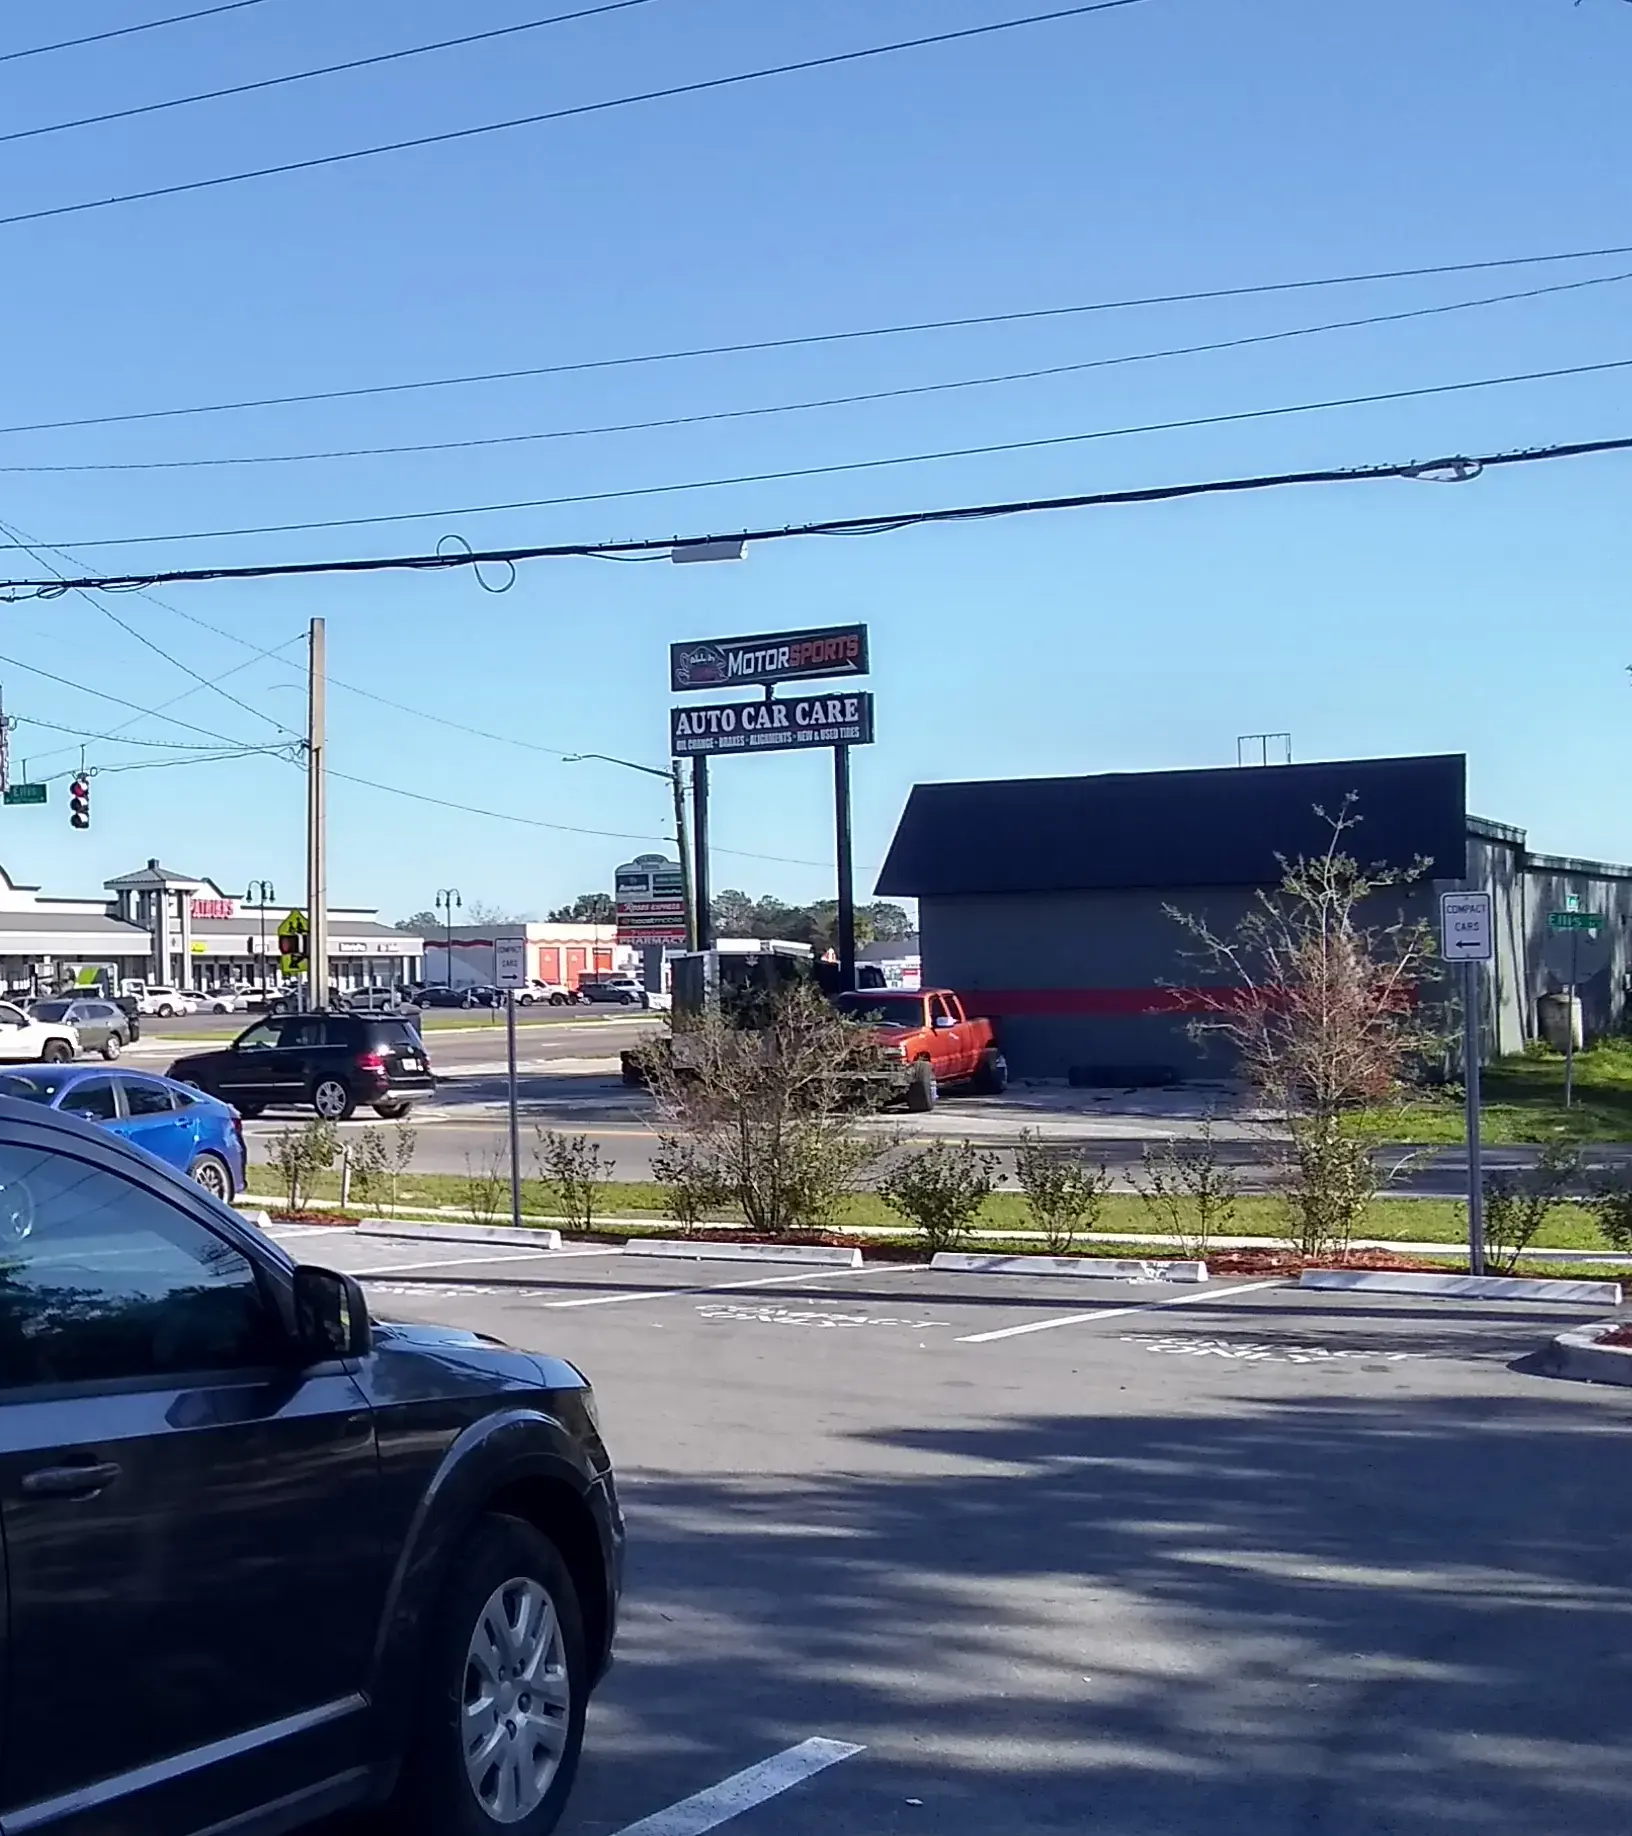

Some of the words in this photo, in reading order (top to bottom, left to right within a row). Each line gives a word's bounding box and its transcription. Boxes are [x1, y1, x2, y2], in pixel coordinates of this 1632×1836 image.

[727, 634, 859, 677] MOTORSPORTS
[676, 708, 736, 735] AUTO
[741, 704, 789, 730] CAR
[795, 698, 859, 726] CARE
[820, 728, 839, 740] USED
[1446, 904, 1487, 914] COMPACT
[1454, 921, 1479, 931] CARS
[619, 936, 686, 945] PHARMACY
